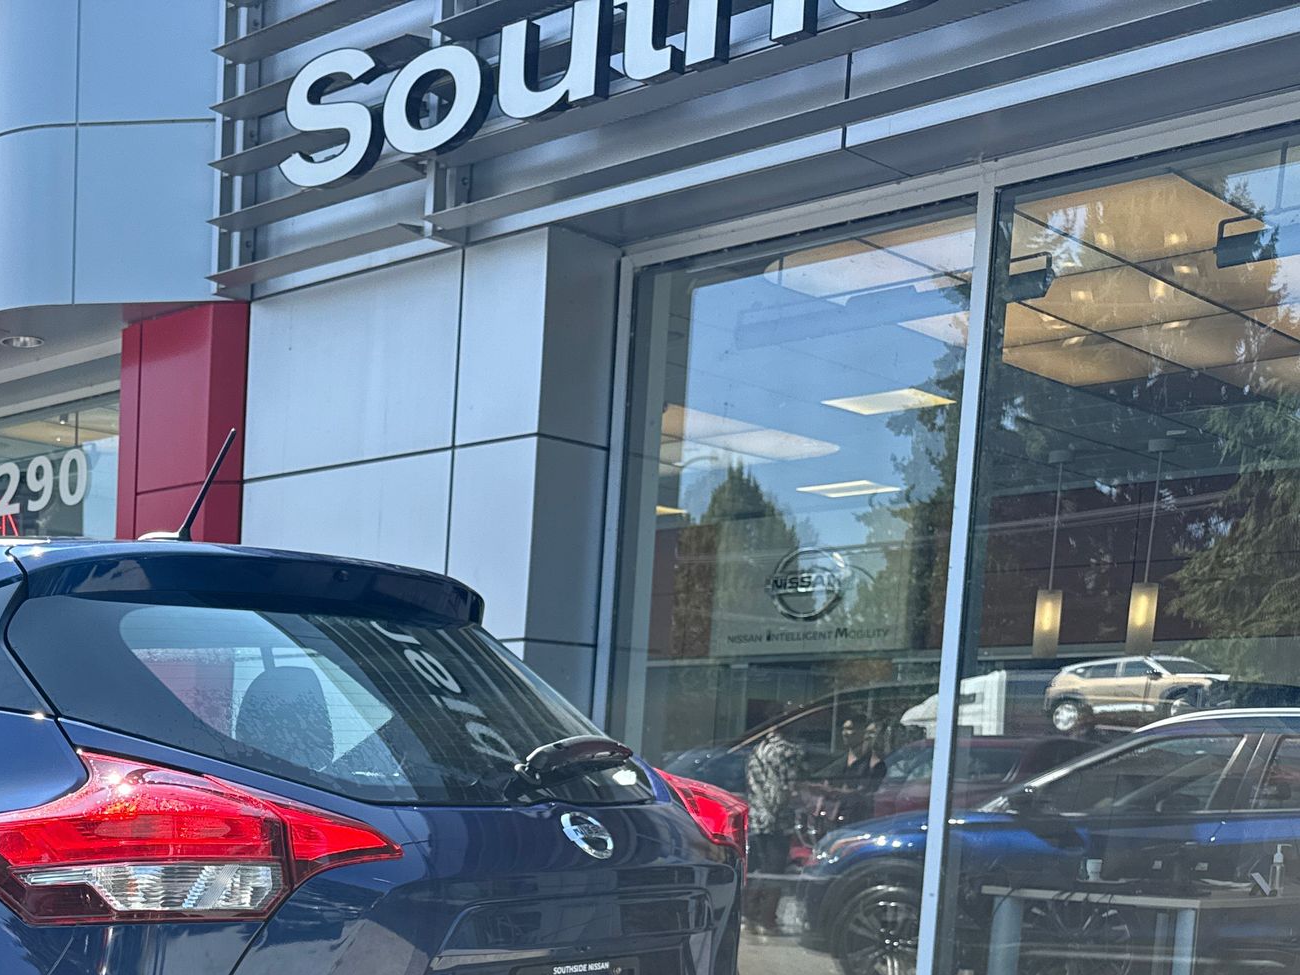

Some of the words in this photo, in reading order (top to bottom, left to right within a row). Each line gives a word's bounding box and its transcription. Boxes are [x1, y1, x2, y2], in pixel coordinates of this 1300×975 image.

[279, 0, 935, 188] Sout
[727, 634, 763, 644] NISSAN
[766, 629, 832, 642] INTELLIGENT
[553, 964, 587, 975] SOUTHSIDE
[588, 961, 610, 971] NISSAN
